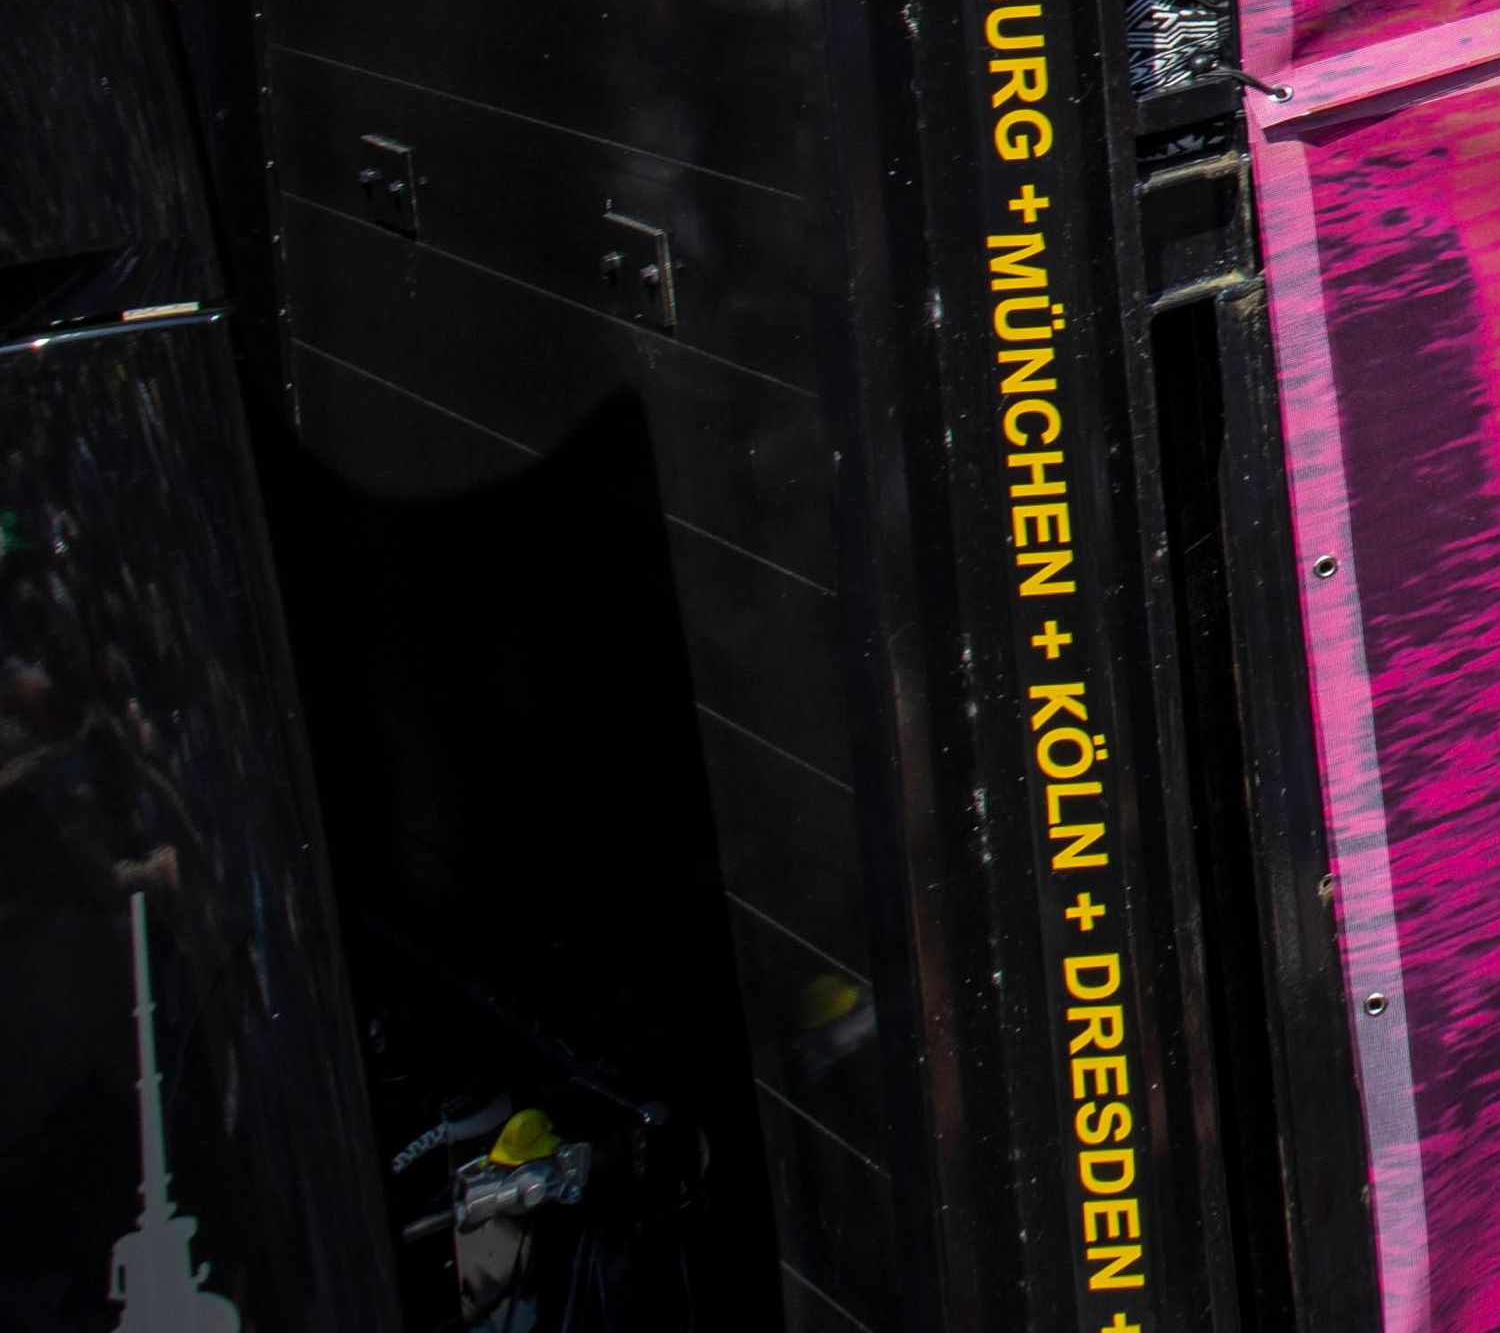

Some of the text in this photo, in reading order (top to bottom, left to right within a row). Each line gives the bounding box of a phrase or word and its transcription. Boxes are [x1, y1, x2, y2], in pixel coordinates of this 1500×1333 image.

[987, 232, 1076, 598] MÜNCHEN
[1029, 681, 1109, 871] KÖLN
[1063, 952, 1145, 1291] DRESDEN
